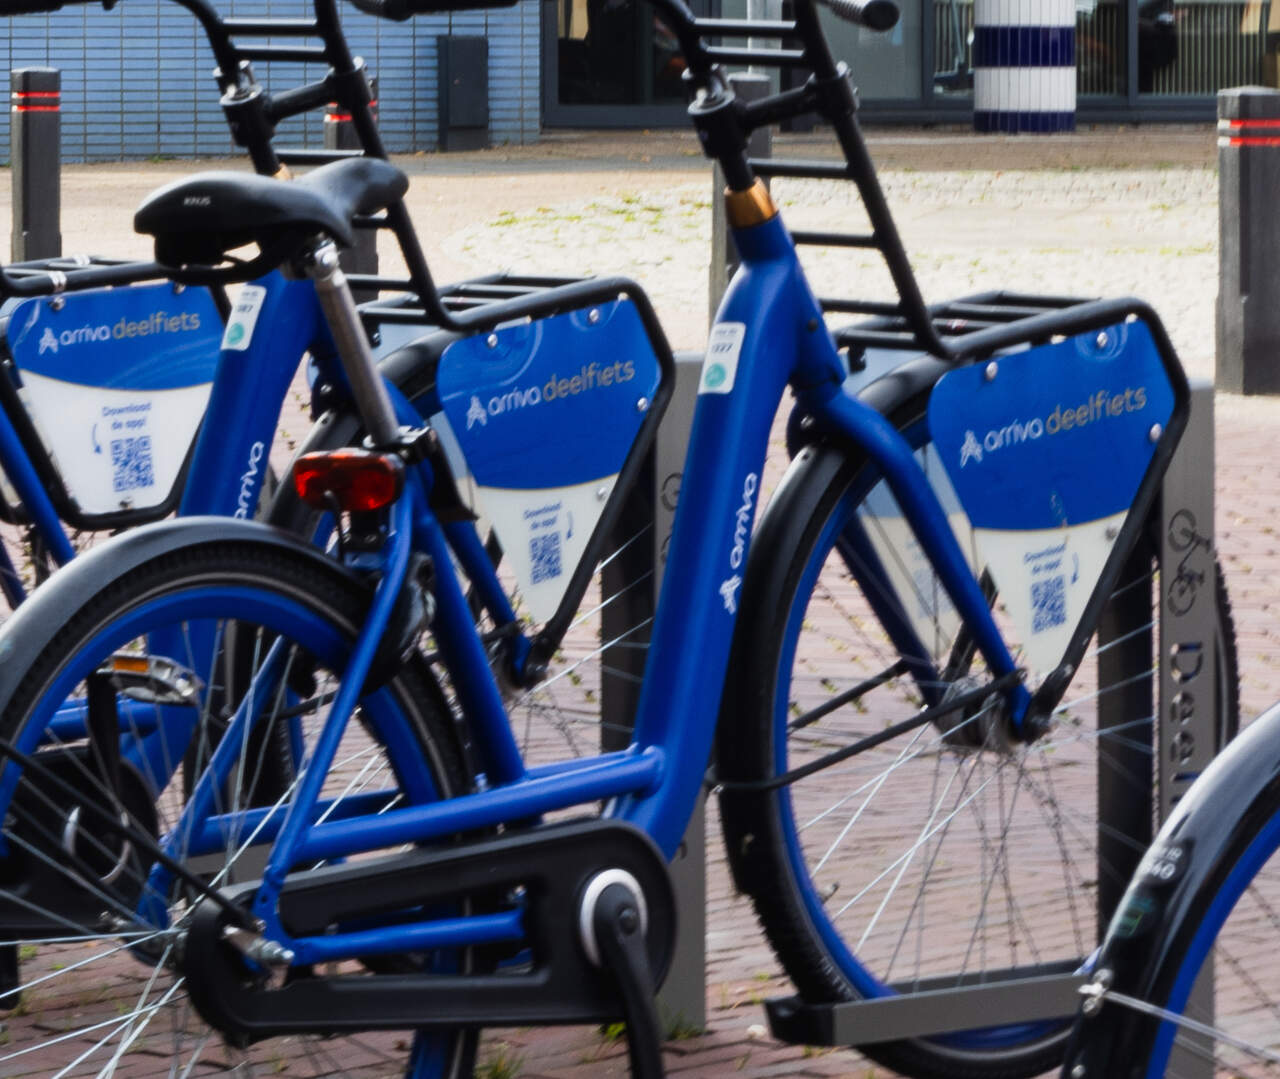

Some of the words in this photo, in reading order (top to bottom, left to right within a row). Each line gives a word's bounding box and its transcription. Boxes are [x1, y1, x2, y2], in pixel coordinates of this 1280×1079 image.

[60, 324, 111, 346] arriva
[112, 310, 201, 339] deelfiets
[103, 402, 152, 417] Download
[488, 386, 541, 416] arriva
[543, 360, 635, 401] deelfiets
[984, 418, 1043, 452] arriva
[1046, 387, 1147, 435] deelfiets
[730, 472, 758, 569] arriva
